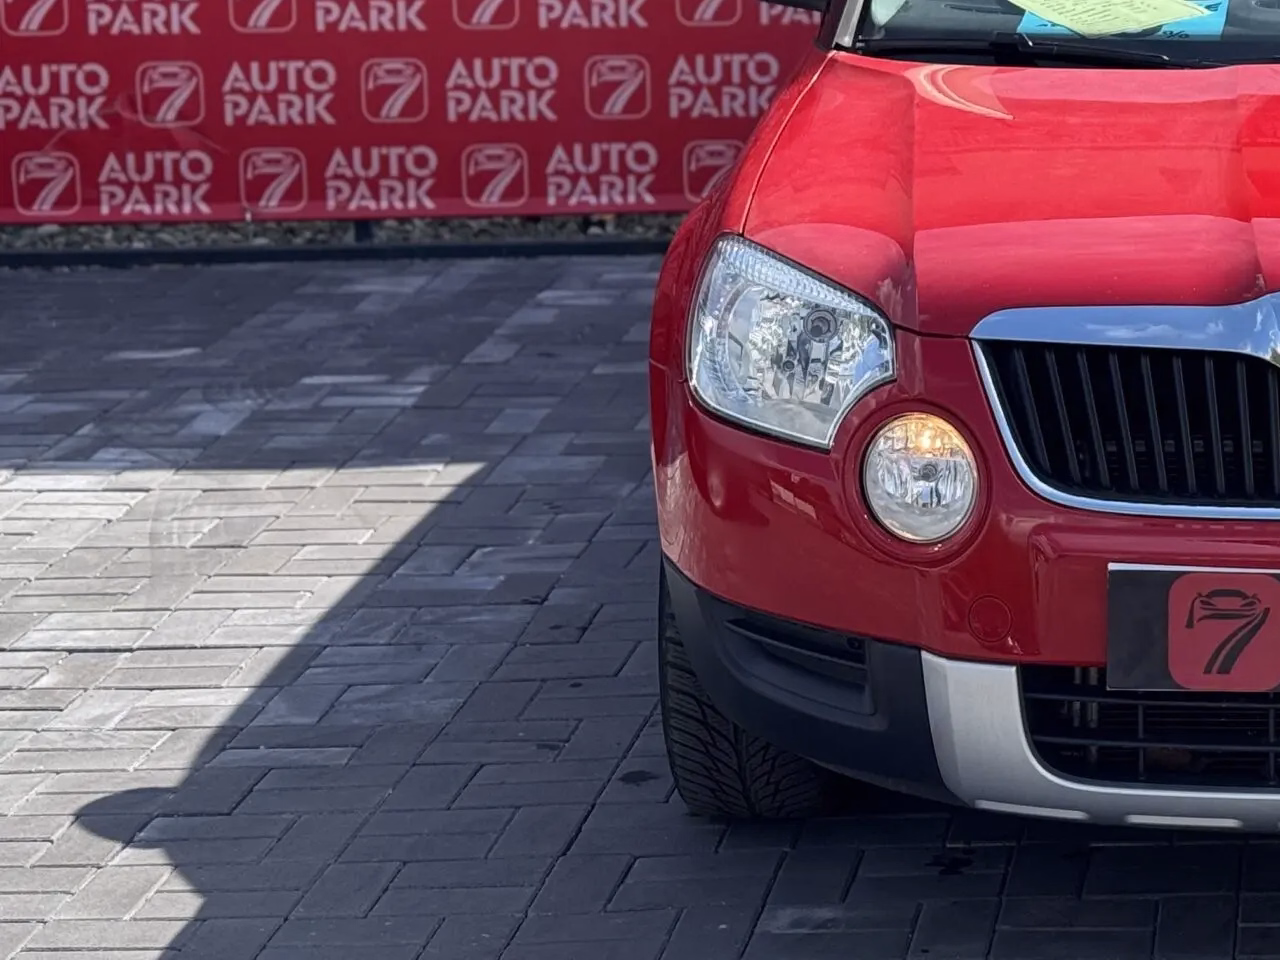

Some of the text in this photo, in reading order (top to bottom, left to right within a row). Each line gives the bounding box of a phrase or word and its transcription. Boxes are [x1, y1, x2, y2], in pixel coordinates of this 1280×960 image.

[88, 2, 200, 35] PARK
[316, 0, 426, 31] PARK
[0, 63, 109, 96] AUTO
[223, 60, 336, 92] AUTO
[446, 57, 558, 89] AUTO
[669, 53, 778, 85] AUTO
[224, 93, 335, 125] PARK
[448, 90, 556, 121] PARK
[670, 86, 776, 118] PARK
[99, 150, 212, 183] AUTO
[325, 146, 437, 178] AUTO
[546, 142, 657, 174] AUTO
[100, 183, 211, 215] PARK
[326, 179, 436, 211] PARK
[547, 174, 656, 206] PARK
